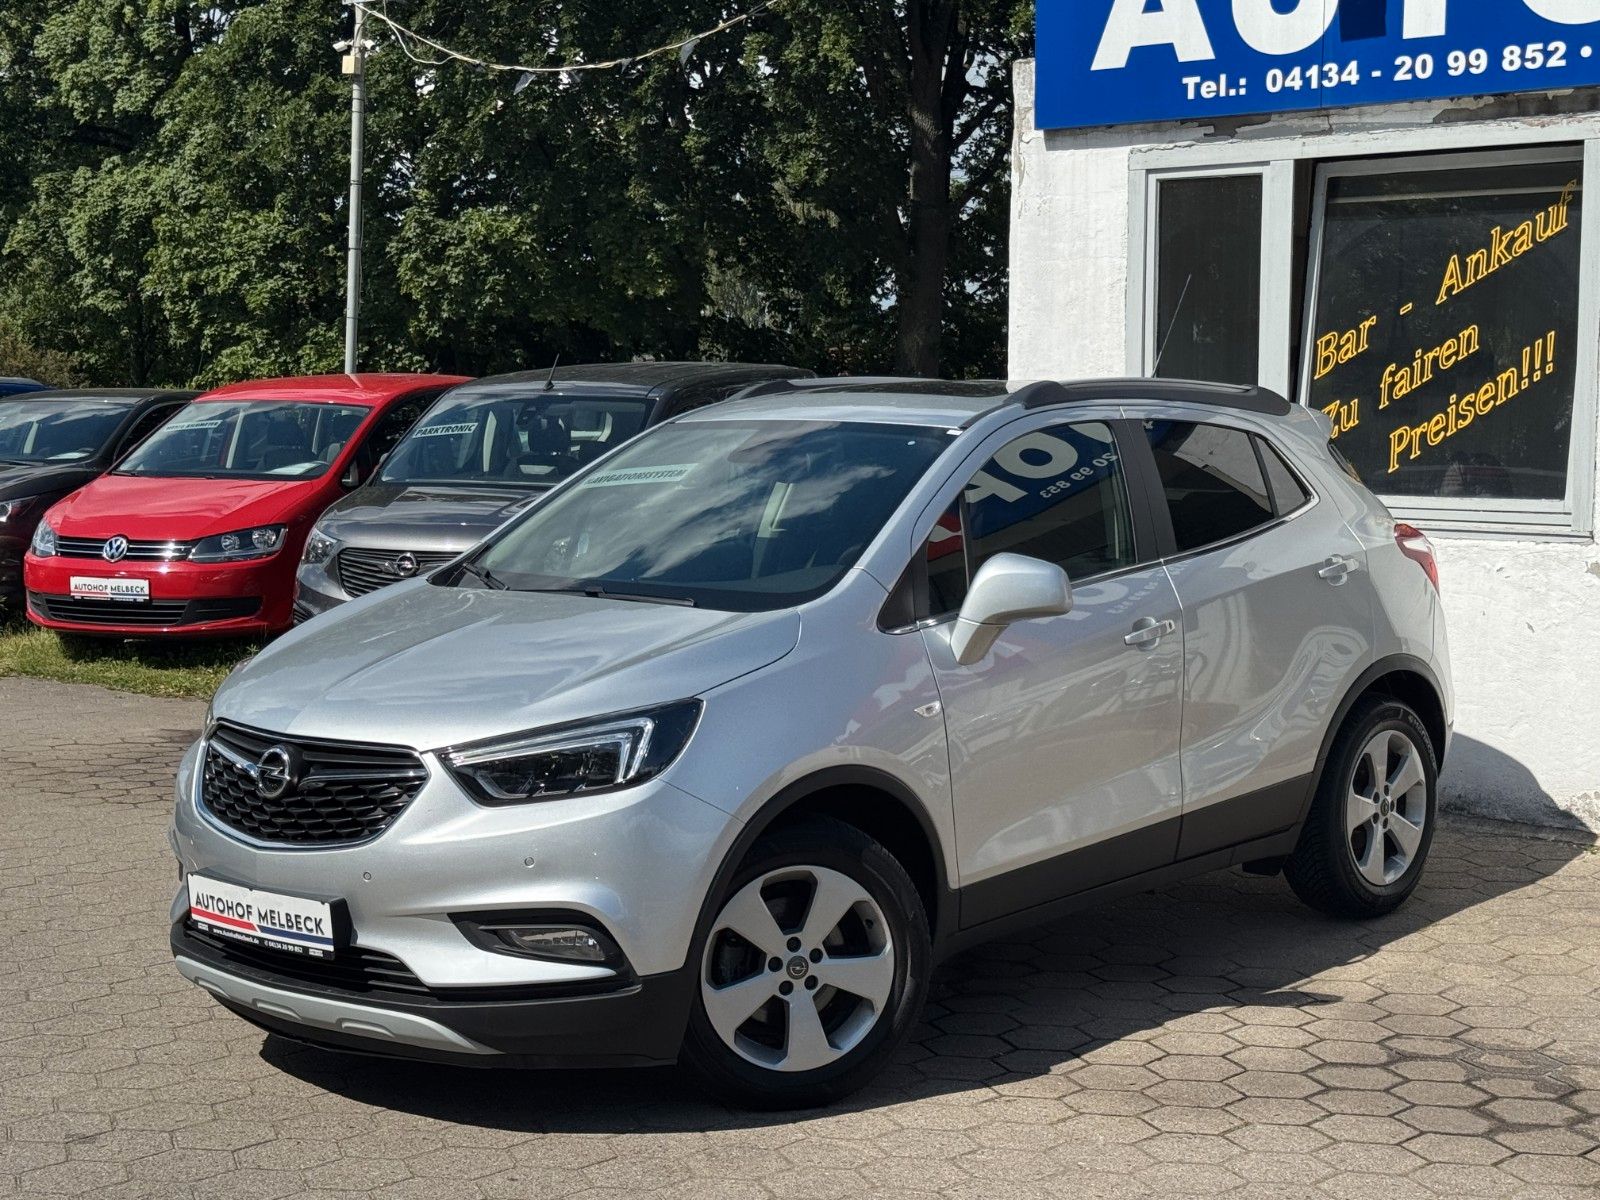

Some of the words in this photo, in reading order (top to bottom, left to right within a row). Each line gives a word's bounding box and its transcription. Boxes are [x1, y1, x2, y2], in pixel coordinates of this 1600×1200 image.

[1090, 0, 1600, 71] AU
[1182, 73, 1246, 100] Tel.:
[1265, 60, 1360, 93] 04134
[1393, 55, 1434, 81] 20
[1447, 48, 1488, 75] 99
[1501, 40, 1567, 72] 852
[1314, 315, 1376, 380] Bar
[1435, 179, 1577, 306] Ankauf
[1379, 324, 1479, 410] fairen
[415, 424, 476, 436] PARKTRONIC
[1388, 331, 1555, 474] Preisen!!!
[111, 585, 145, 593] MELBECK
[195, 891, 253, 920] AUTOHOF
[257, 907, 325, 935] MELBECK
